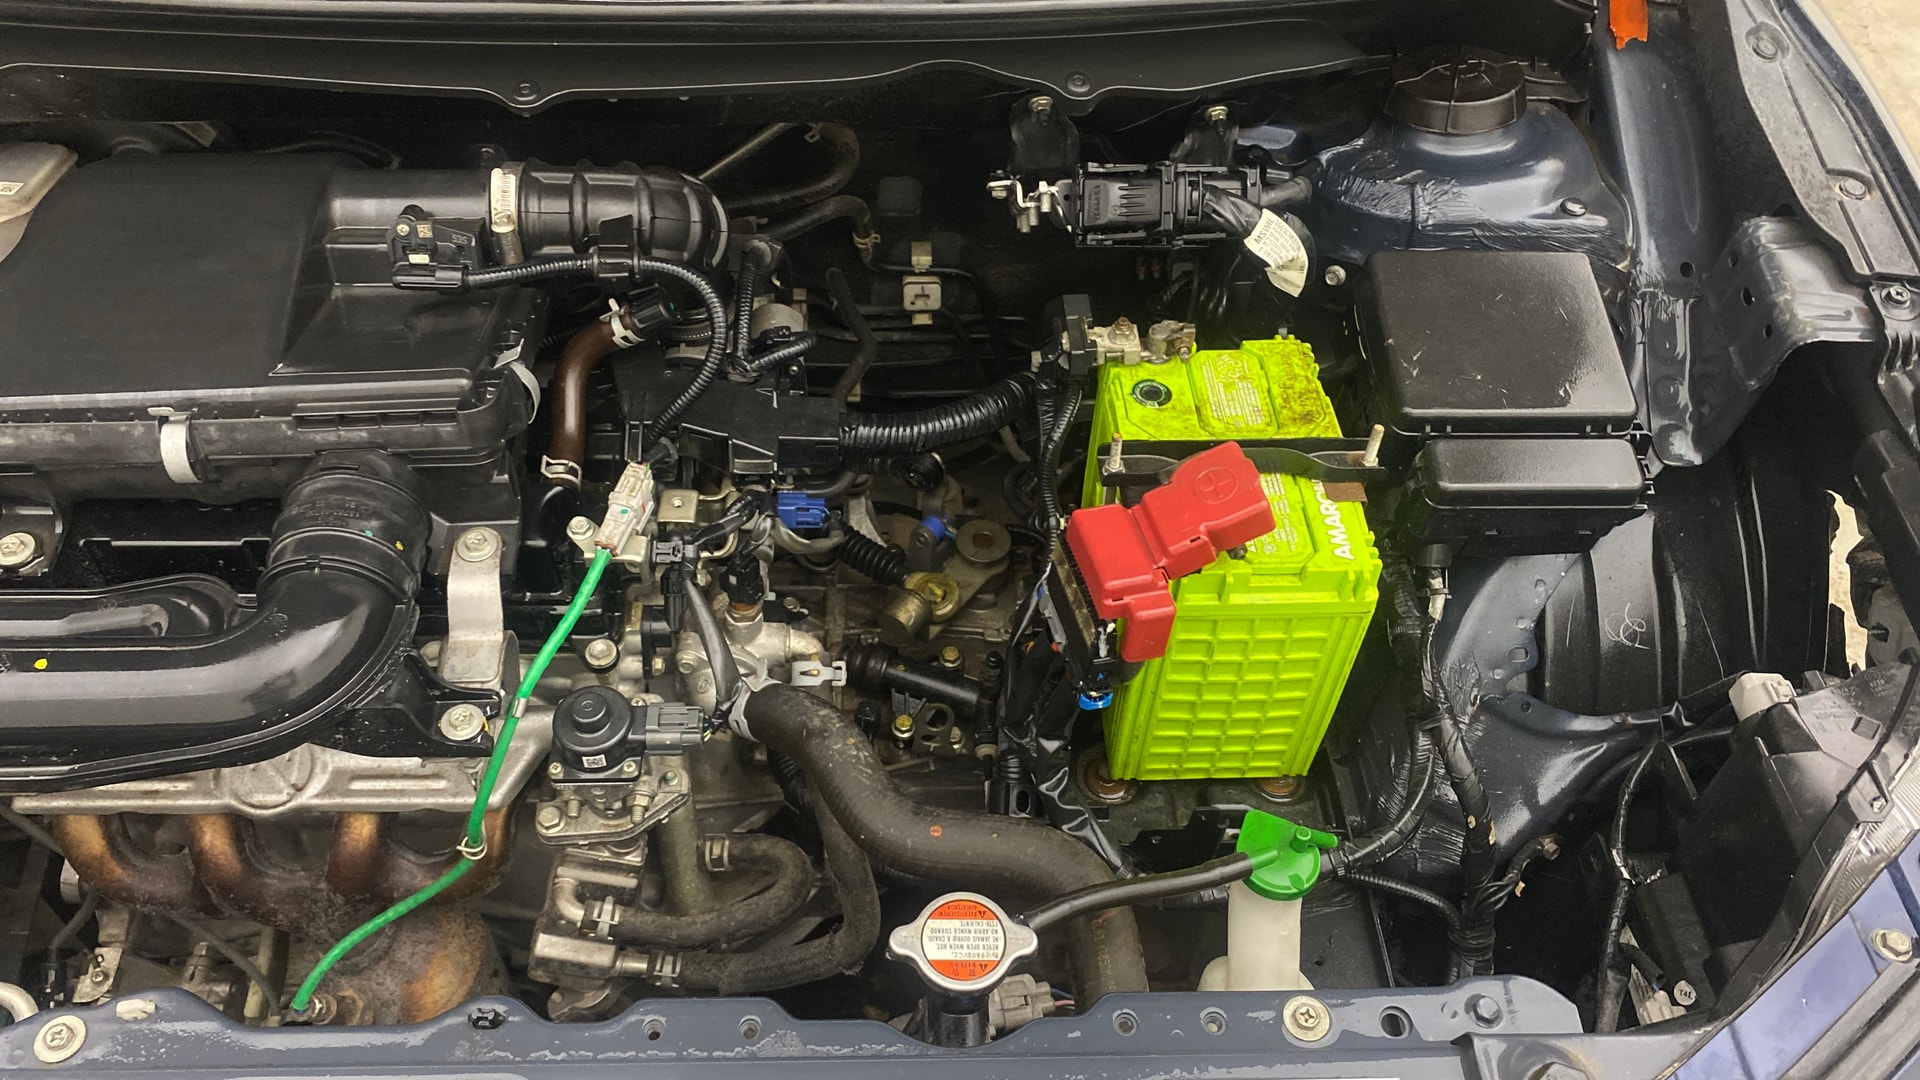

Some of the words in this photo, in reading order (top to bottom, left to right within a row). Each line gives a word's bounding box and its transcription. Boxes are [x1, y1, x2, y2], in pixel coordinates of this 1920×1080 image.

[1254, 218, 1275, 245] MSWIL
[930, 927, 952, 935] CUANDO
[952, 935, 971, 943] OUVRIR
[972, 935, 990, 943] JAMAIS
[991, 935, 999, 943] NE
[949, 943, 964, 951] WHEN
[966, 943, 981, 951] OPEN
[981, 943, 999, 951] NEVER
[950, 961, 976, 969] WARNING
